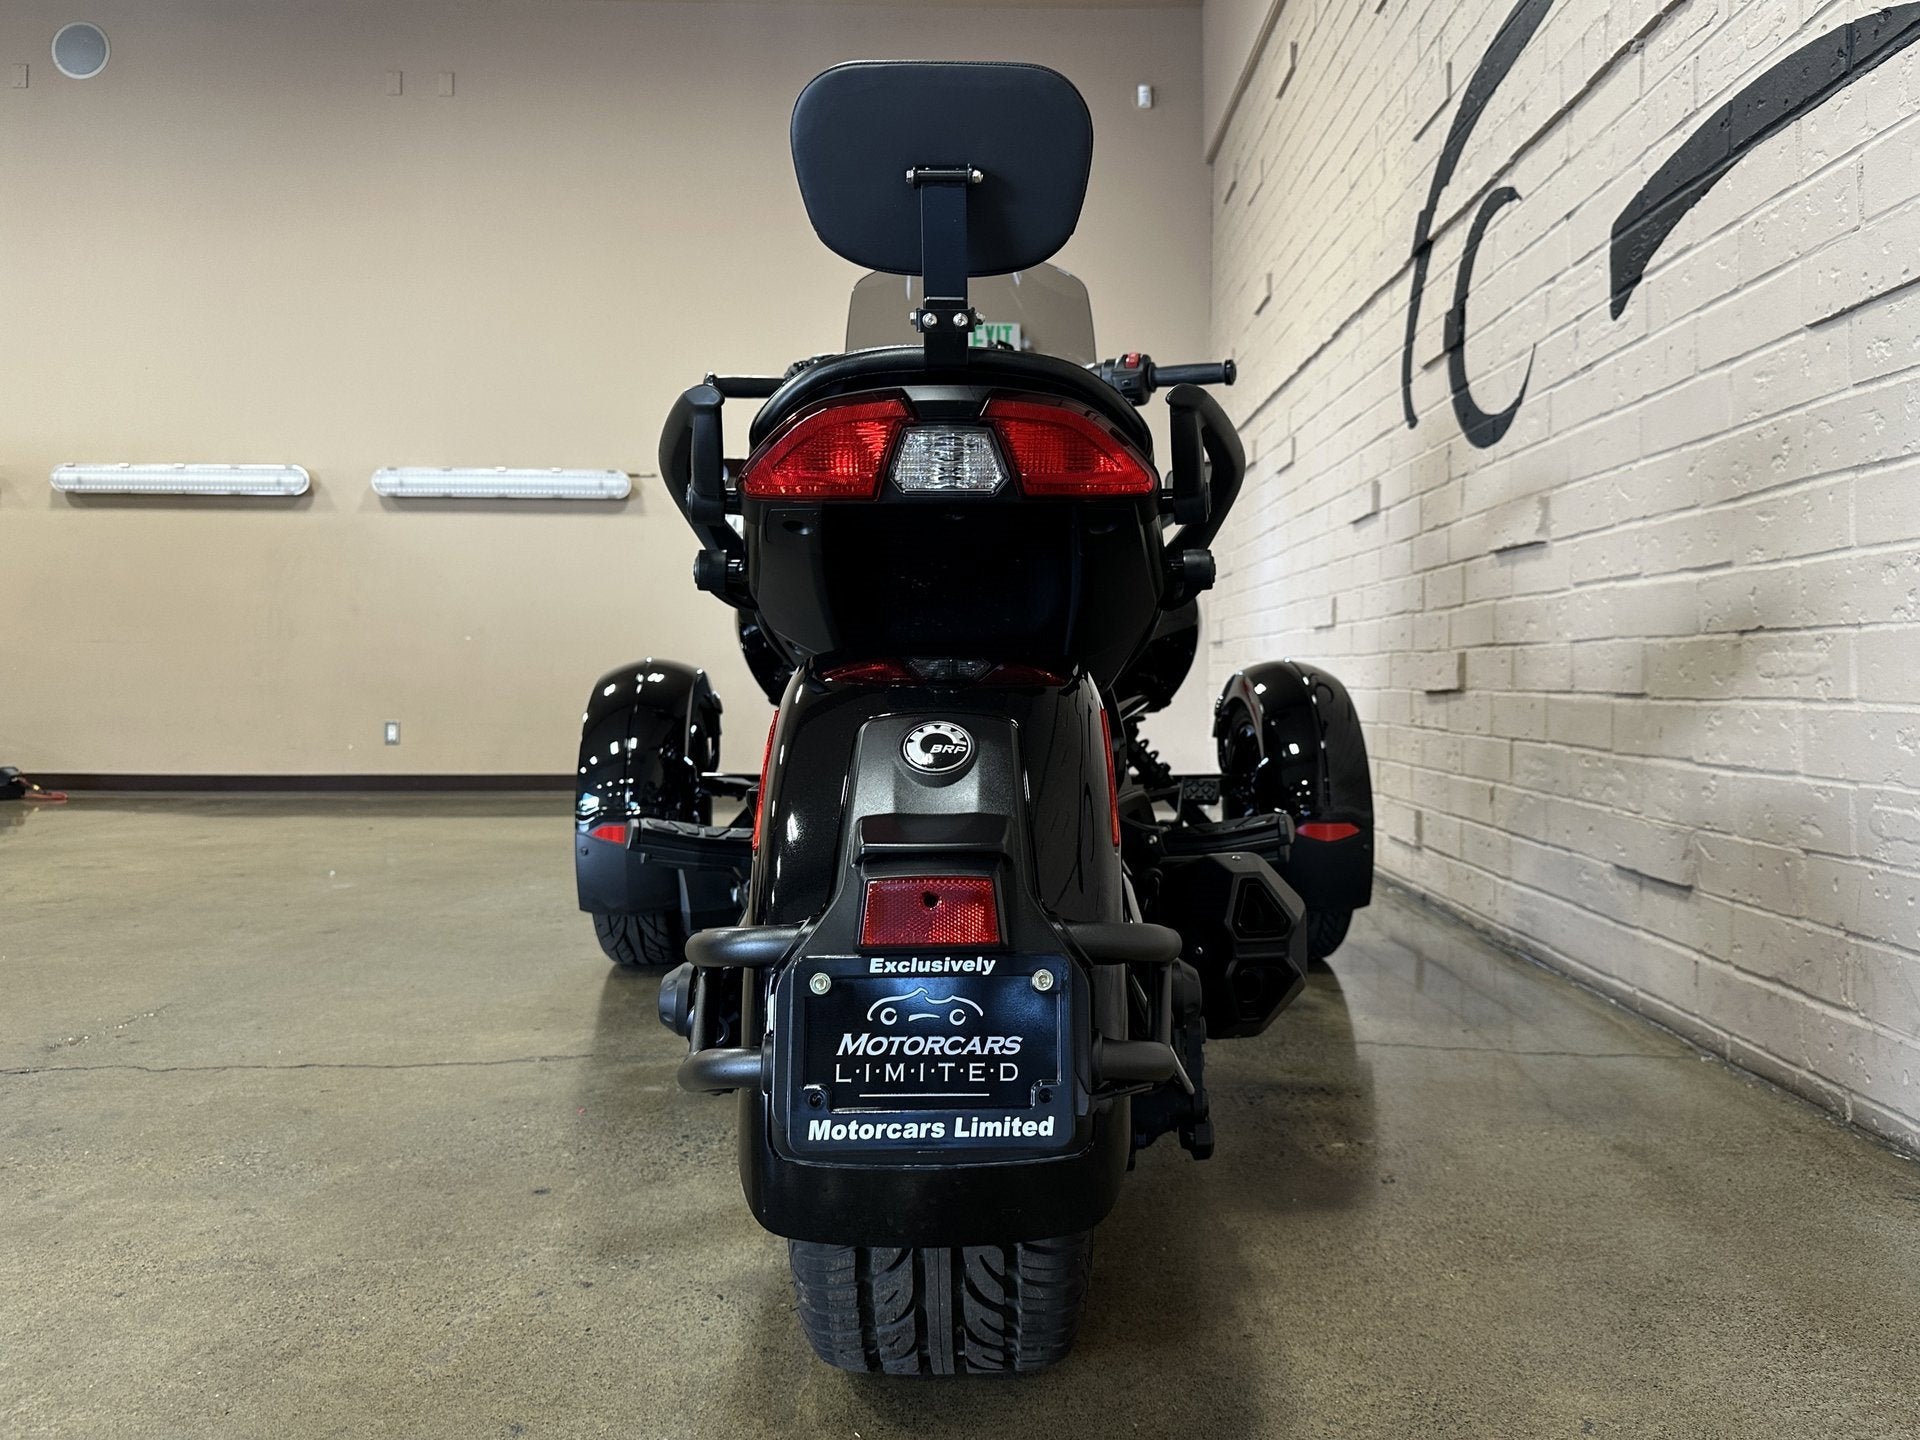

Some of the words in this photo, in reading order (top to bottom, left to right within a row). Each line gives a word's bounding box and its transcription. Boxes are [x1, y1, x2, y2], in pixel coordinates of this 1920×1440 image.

[930, 744, 967, 754] BRP
[869, 956, 996, 975] Exclusively
[808, 1119, 945, 1141] Motorcars
[954, 1116, 1055, 1138] Limited
